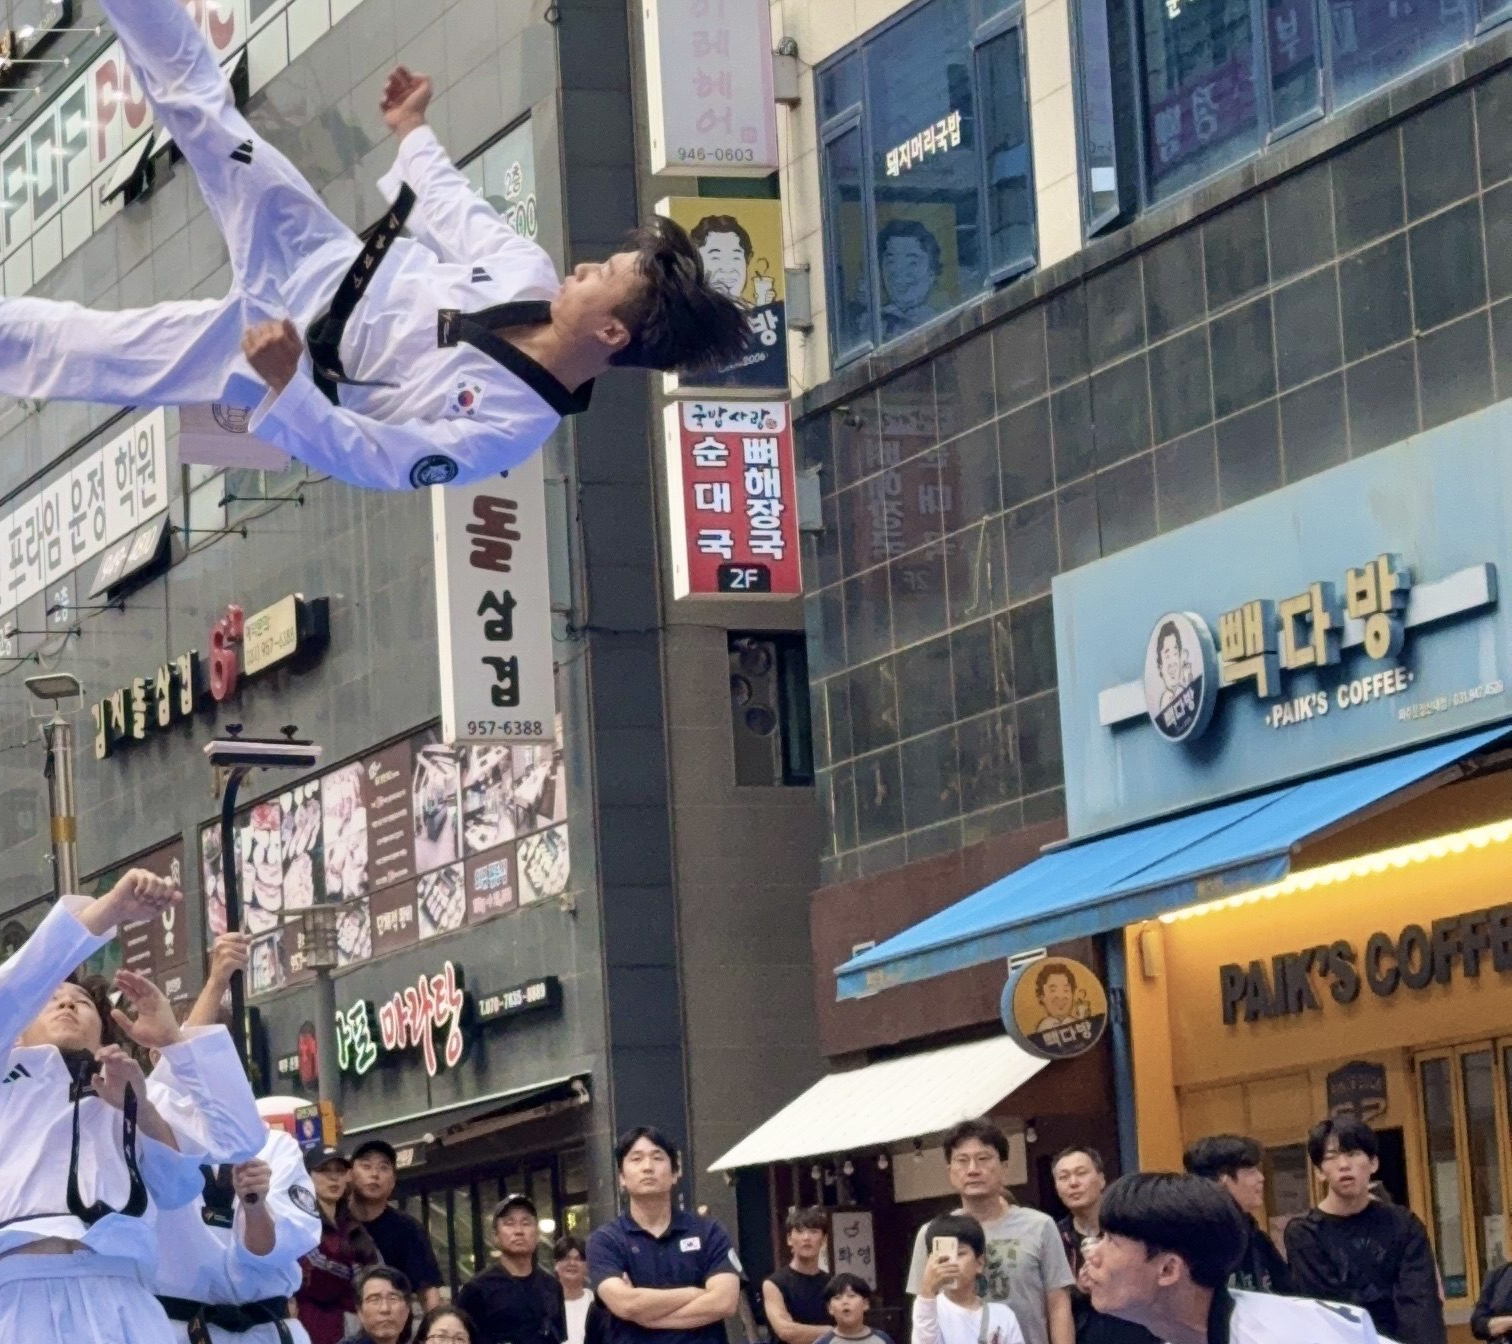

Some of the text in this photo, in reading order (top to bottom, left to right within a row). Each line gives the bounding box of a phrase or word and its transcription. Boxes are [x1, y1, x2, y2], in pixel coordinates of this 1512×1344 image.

[676, 146, 755, 163] 946-0603
[885, 110, 963, 177] 돼지머리국밥
[691, 404, 770, 430] 국밥사랑
[8, 492, 63, 592] 프라임
[68, 460, 107, 555] 운정
[114, 423, 157, 518] 학원
[691, 435, 736, 560] 순대국
[741, 436, 786, 561] 뼈해장국
[465, 469, 522, 708] 돌삼겹
[728, 568, 760, 590] 2F
[1218, 552, 1400, 698] 빽다방
[467, 719, 544, 736] 957-6388
[1163, 686, 1196, 727] 빽다방
[1272, 667, 1410, 729] PAIK'S COFFEE
[1219, 939, 1362, 1026] PAIK'S
[378, 959, 465, 1077] 마라탕
[1042, 1020, 1093, 1047] 빽다방
